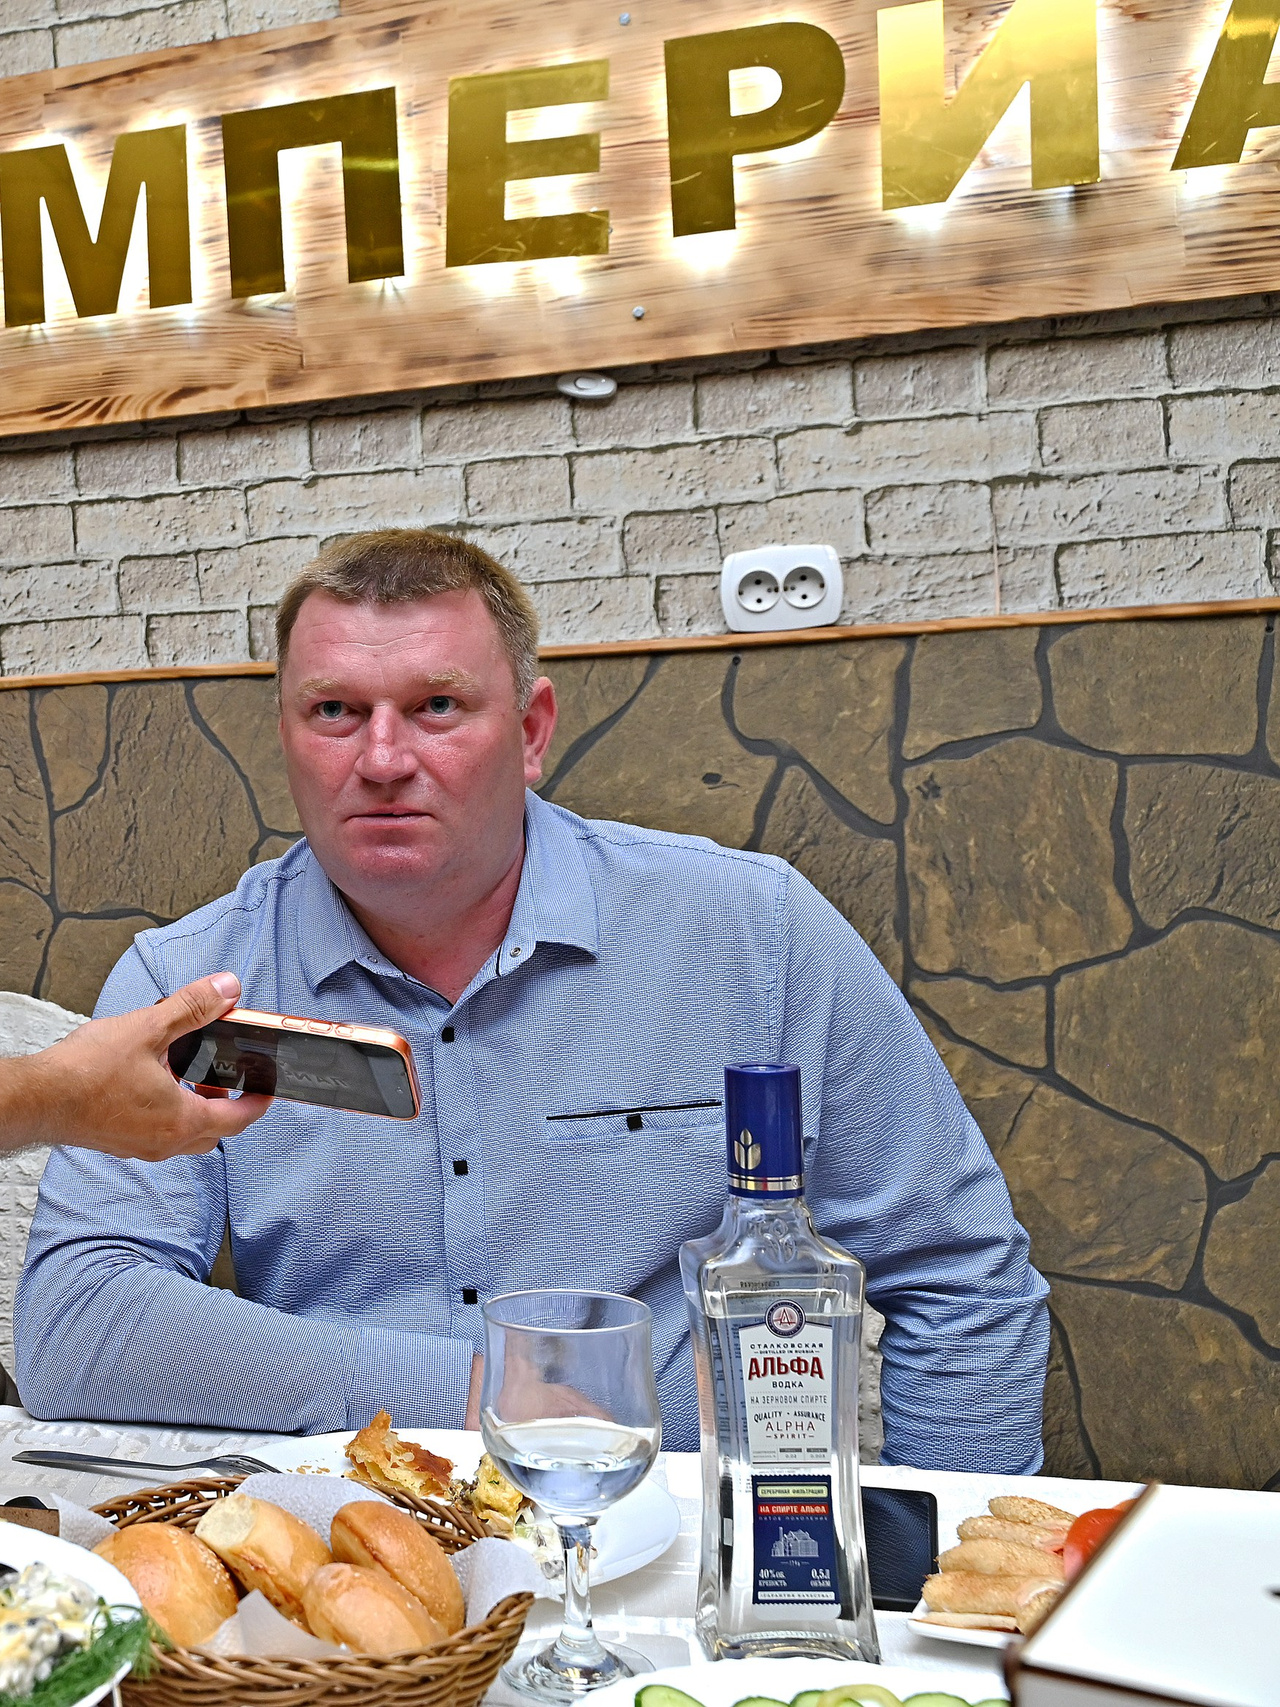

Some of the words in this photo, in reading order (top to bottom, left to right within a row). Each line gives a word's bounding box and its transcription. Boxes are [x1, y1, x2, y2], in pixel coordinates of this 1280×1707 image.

[748, 1356, 825, 1380] АЛЬФА
[772, 1381, 804, 1389] ВОДКА
[750, 1396, 760, 1404] НА
[762, 1395, 798, 1404] ЗЕРНОВОМ
[800, 1395, 828, 1404] СПИРТЕ
[753, 1411, 783, 1423] QUALITY
[793, 1411, 826, 1422] ASSURANCE
[765, 1421, 816, 1431] ALPHA
[760, 1505, 770, 1513] НА
[771, 1505, 799, 1513] СПИРТЕ
[800, 1505, 827, 1513] АЛЬФА
